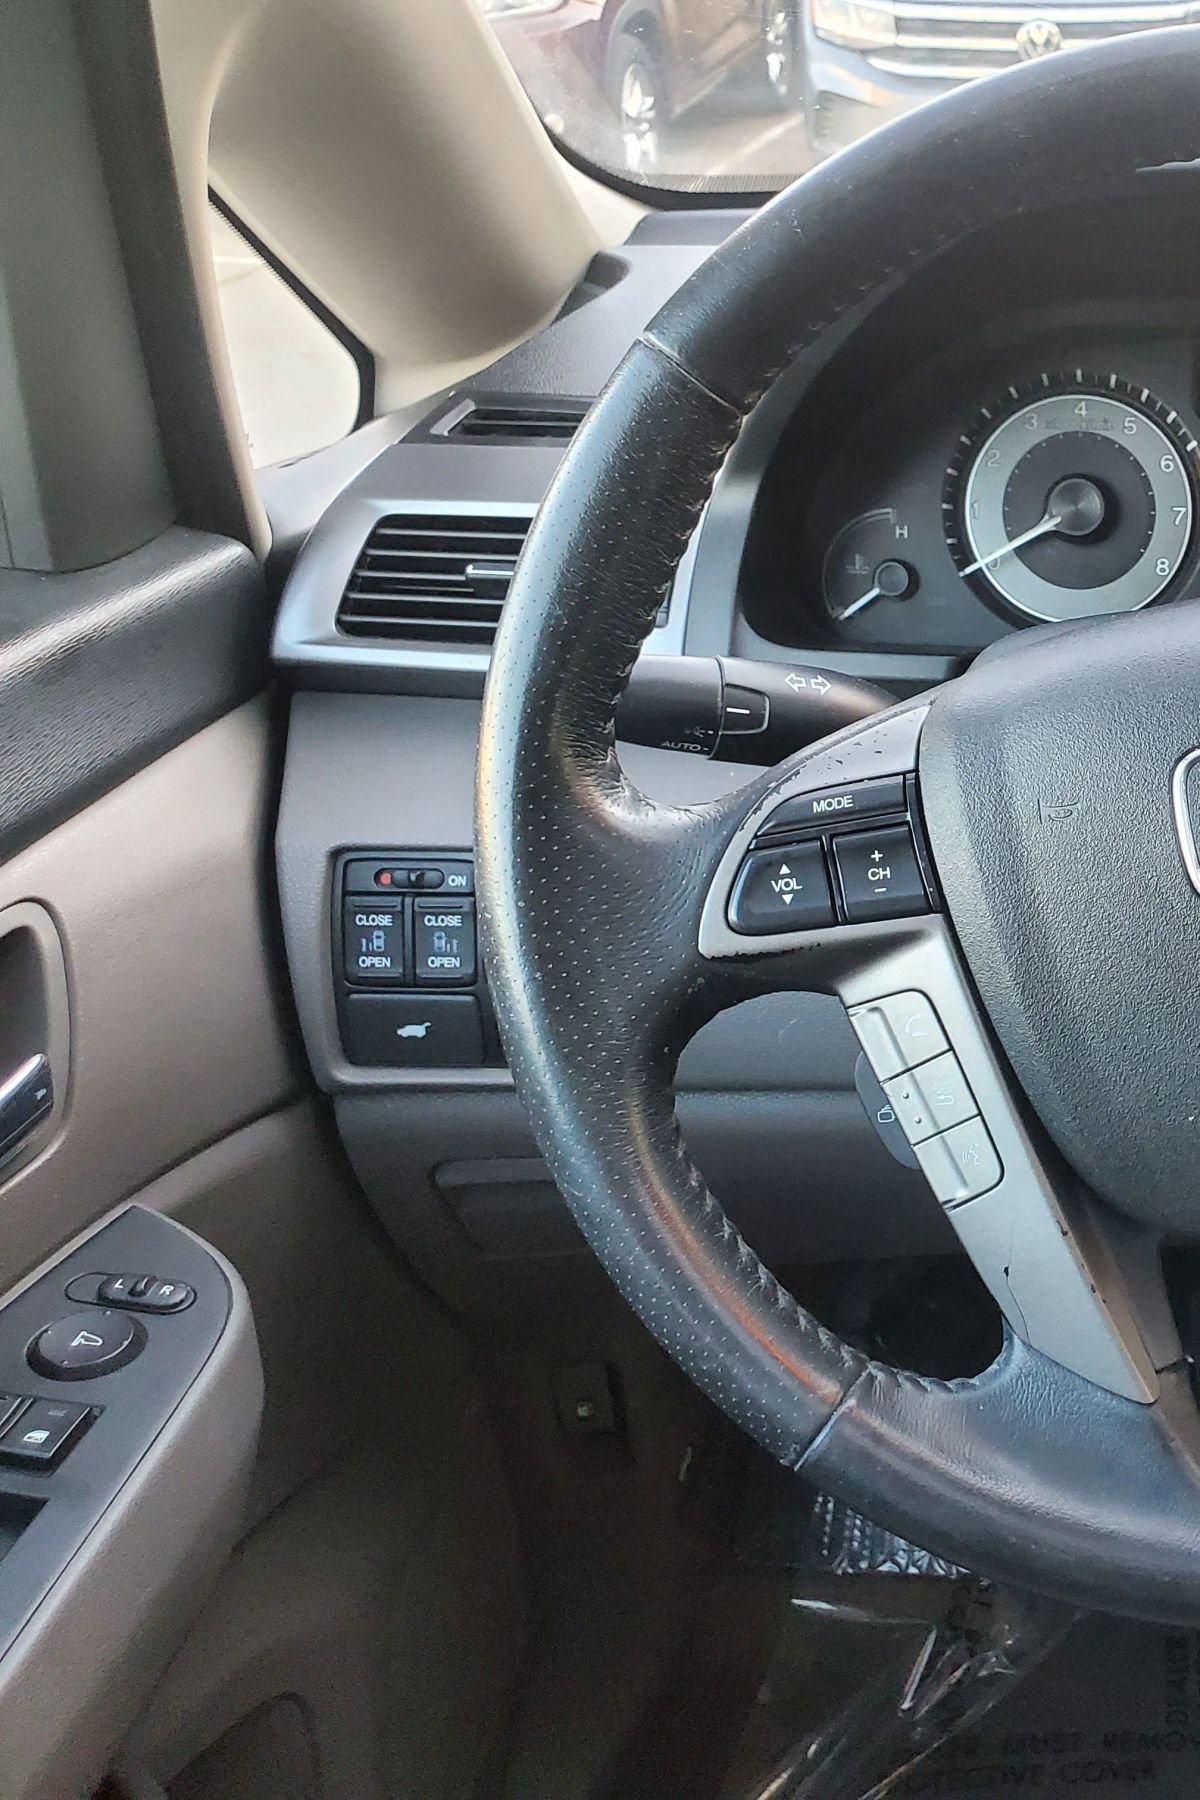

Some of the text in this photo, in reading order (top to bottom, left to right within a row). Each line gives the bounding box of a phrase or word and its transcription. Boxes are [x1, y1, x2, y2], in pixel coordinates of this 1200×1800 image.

[1074, 400, 1088, 418] 4
[1024, 413, 1038, 430] 3
[1123, 417, 1137, 435] 5
[987, 449, 1001, 467] 2
[1159, 454, 1174, 472] 6
[970, 502, 979, 520] 1
[1171, 507, 1185, 526] 7
[894, 525, 909, 539] H
[1155, 559, 1170, 576] 8
[661, 740, 701, 752] AUTO
[812, 795, 854, 813] MODE
[448, 874, 467, 887] ON
[867, 866, 891, 881] CH
[770, 876, 803, 892] VOL
[355, 914, 394, 927] CLOSE
[424, 914, 463, 927] CLOSE
[358, 956, 391, 969] OPEN
[427, 956, 461, 969] OPEN
[114, 1278, 175, 1296] L R
[1055, 1759, 1156, 1785] COVER
